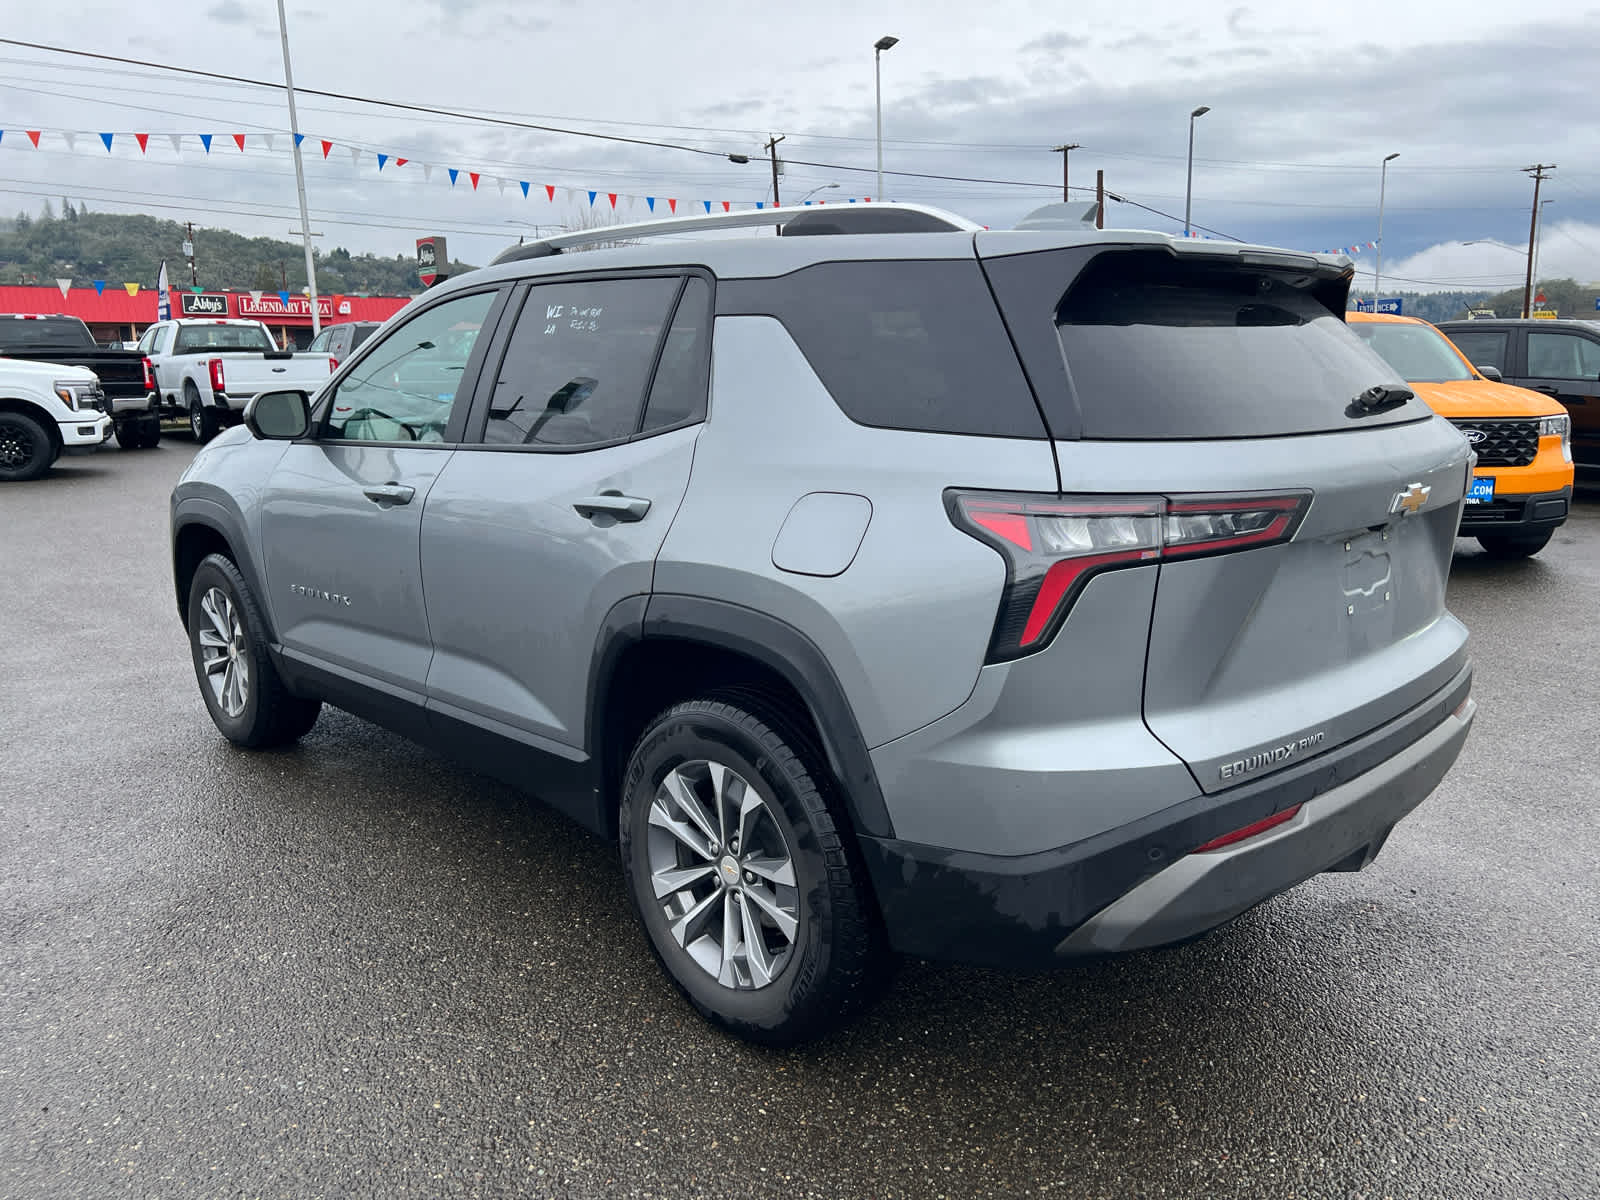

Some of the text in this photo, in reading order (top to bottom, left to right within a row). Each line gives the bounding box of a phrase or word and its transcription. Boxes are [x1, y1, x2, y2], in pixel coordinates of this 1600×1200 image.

[188, 296, 222, 312] Abby's
[243, 299, 300, 313] LEGENDARY
[1360, 303, 1390, 313] ENTRNCE
[1221, 742, 1296, 778] EQUINOX
